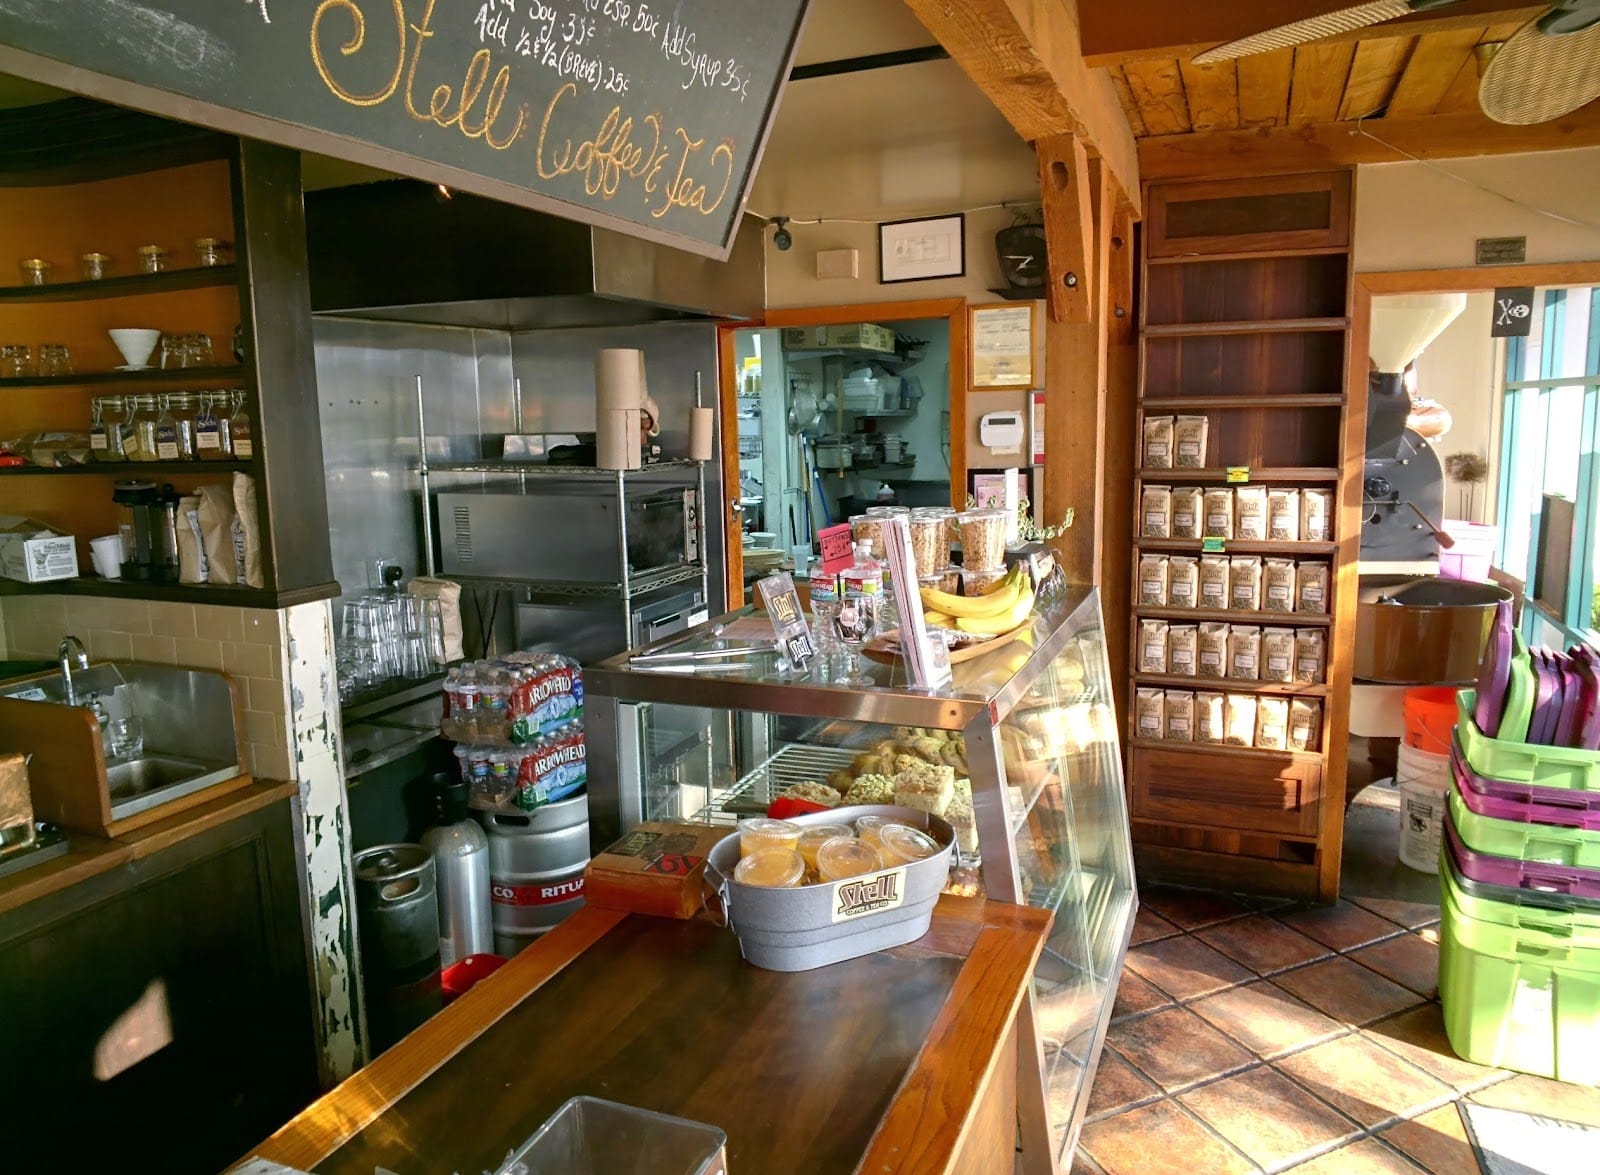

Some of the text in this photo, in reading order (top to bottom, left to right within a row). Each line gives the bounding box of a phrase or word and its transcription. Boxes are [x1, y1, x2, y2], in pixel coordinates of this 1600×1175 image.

[474, 2, 510, 47] Add
[535, 82, 662, 200] Coffee
[651, 126, 733, 218] Tea
[838, 873, 897, 914] Stell
